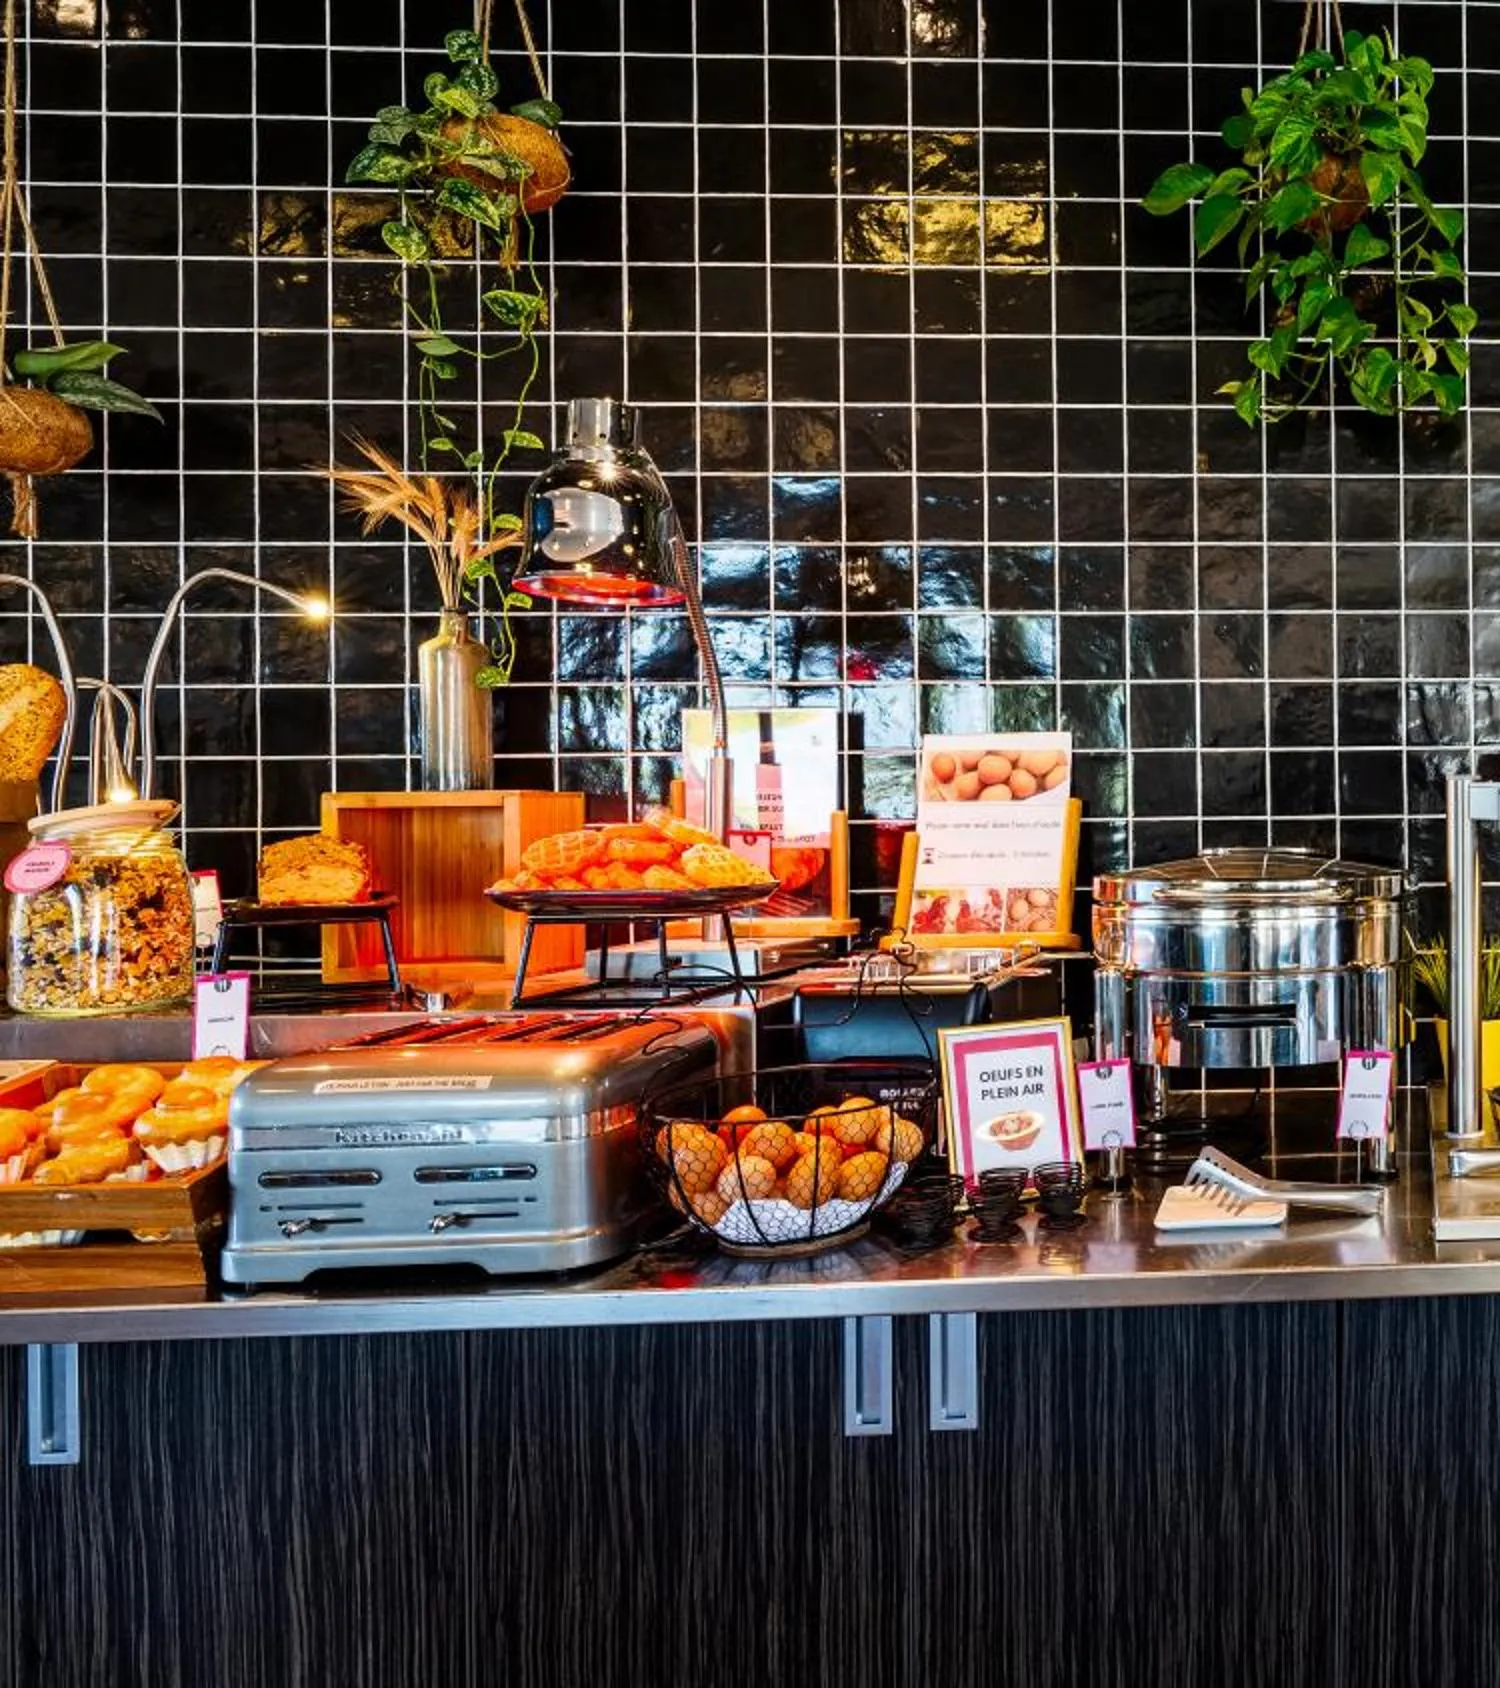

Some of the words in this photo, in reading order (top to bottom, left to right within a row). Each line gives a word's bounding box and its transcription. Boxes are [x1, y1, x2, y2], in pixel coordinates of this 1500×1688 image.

[979, 1068, 1023, 1083] OEUFS
[1025, 1066, 1044, 1078] EN
[981, 1085, 1019, 1100] PLEIN
[1022, 1083, 1044, 1096] AIR
